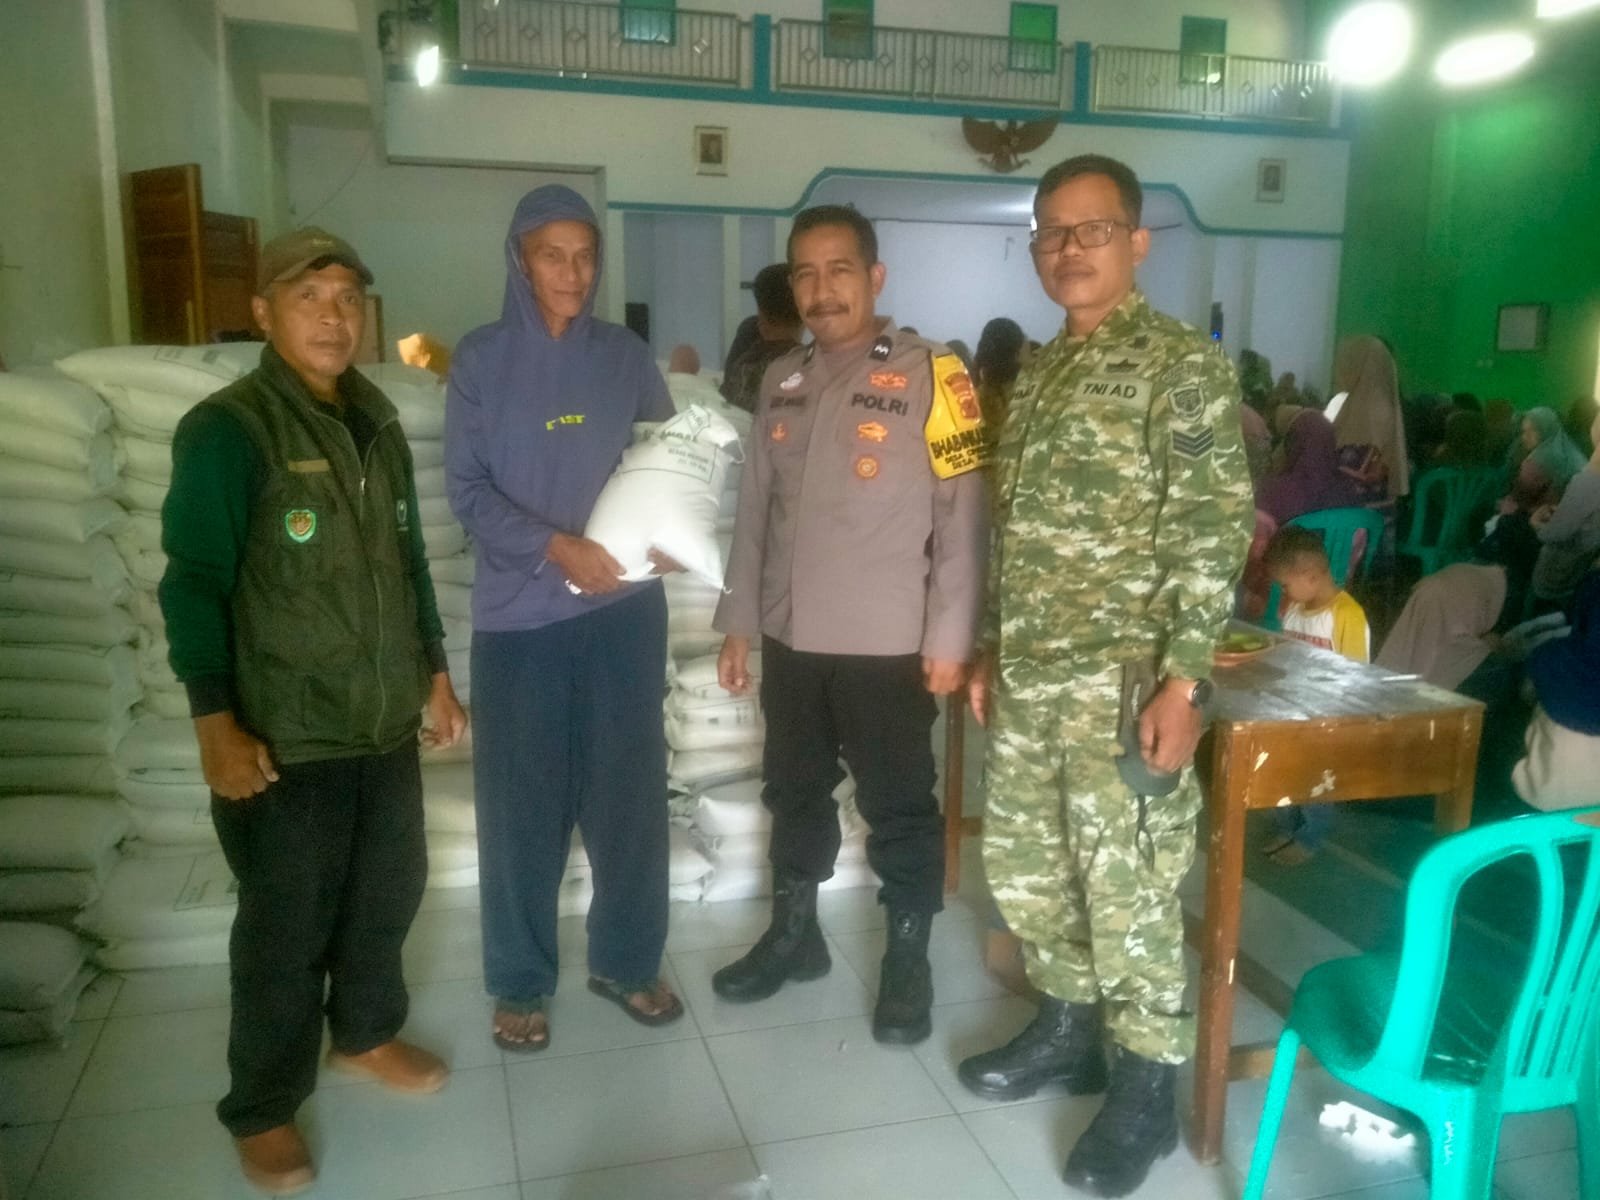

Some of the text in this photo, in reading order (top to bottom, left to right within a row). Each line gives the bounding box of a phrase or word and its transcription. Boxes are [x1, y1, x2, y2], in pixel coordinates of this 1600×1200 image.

[1083, 383, 1137, 399] TNI AD
[851, 393, 909, 417] POLRI
